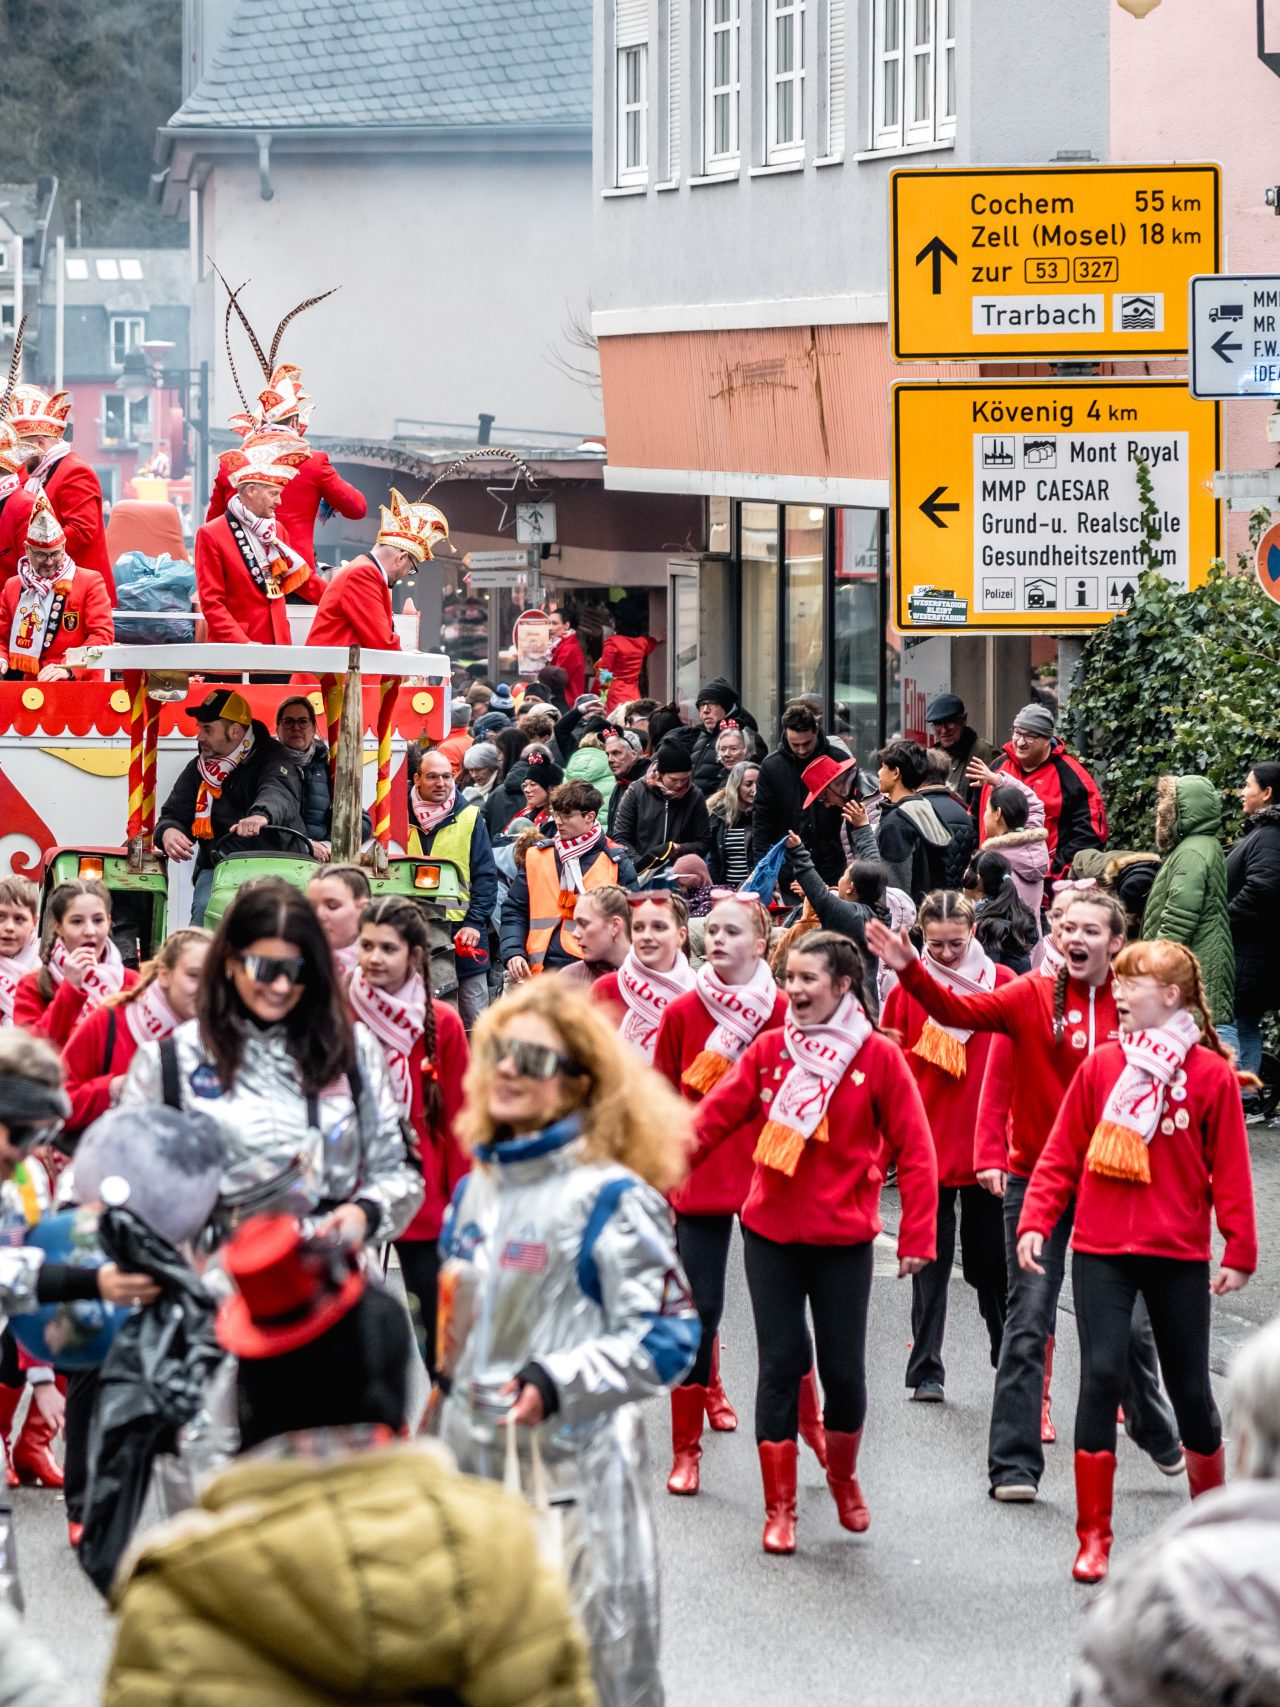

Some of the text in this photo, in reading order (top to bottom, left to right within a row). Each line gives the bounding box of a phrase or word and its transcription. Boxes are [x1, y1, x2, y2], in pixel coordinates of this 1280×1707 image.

[971, 190, 1201, 216] Cochem 55 km
[971, 223, 1201, 248] Zell (Mosel) 18 km
[971, 261, 1113, 283] zur 53 327
[1253, 291, 1280, 307] MM
[981, 303, 1096, 326] Trarbach
[1253, 316, 1275, 332] MR
[972, 400, 1137, 427] Kövenig 4 km
[1070, 440, 1180, 468] Mont Royal
[982, 479, 1110, 502] MMP CAESAR
[913, 599, 966, 608] WESERSTADION
[985, 588, 1013, 600] Polizei
[912, 613, 966, 621] WESERSTADION
